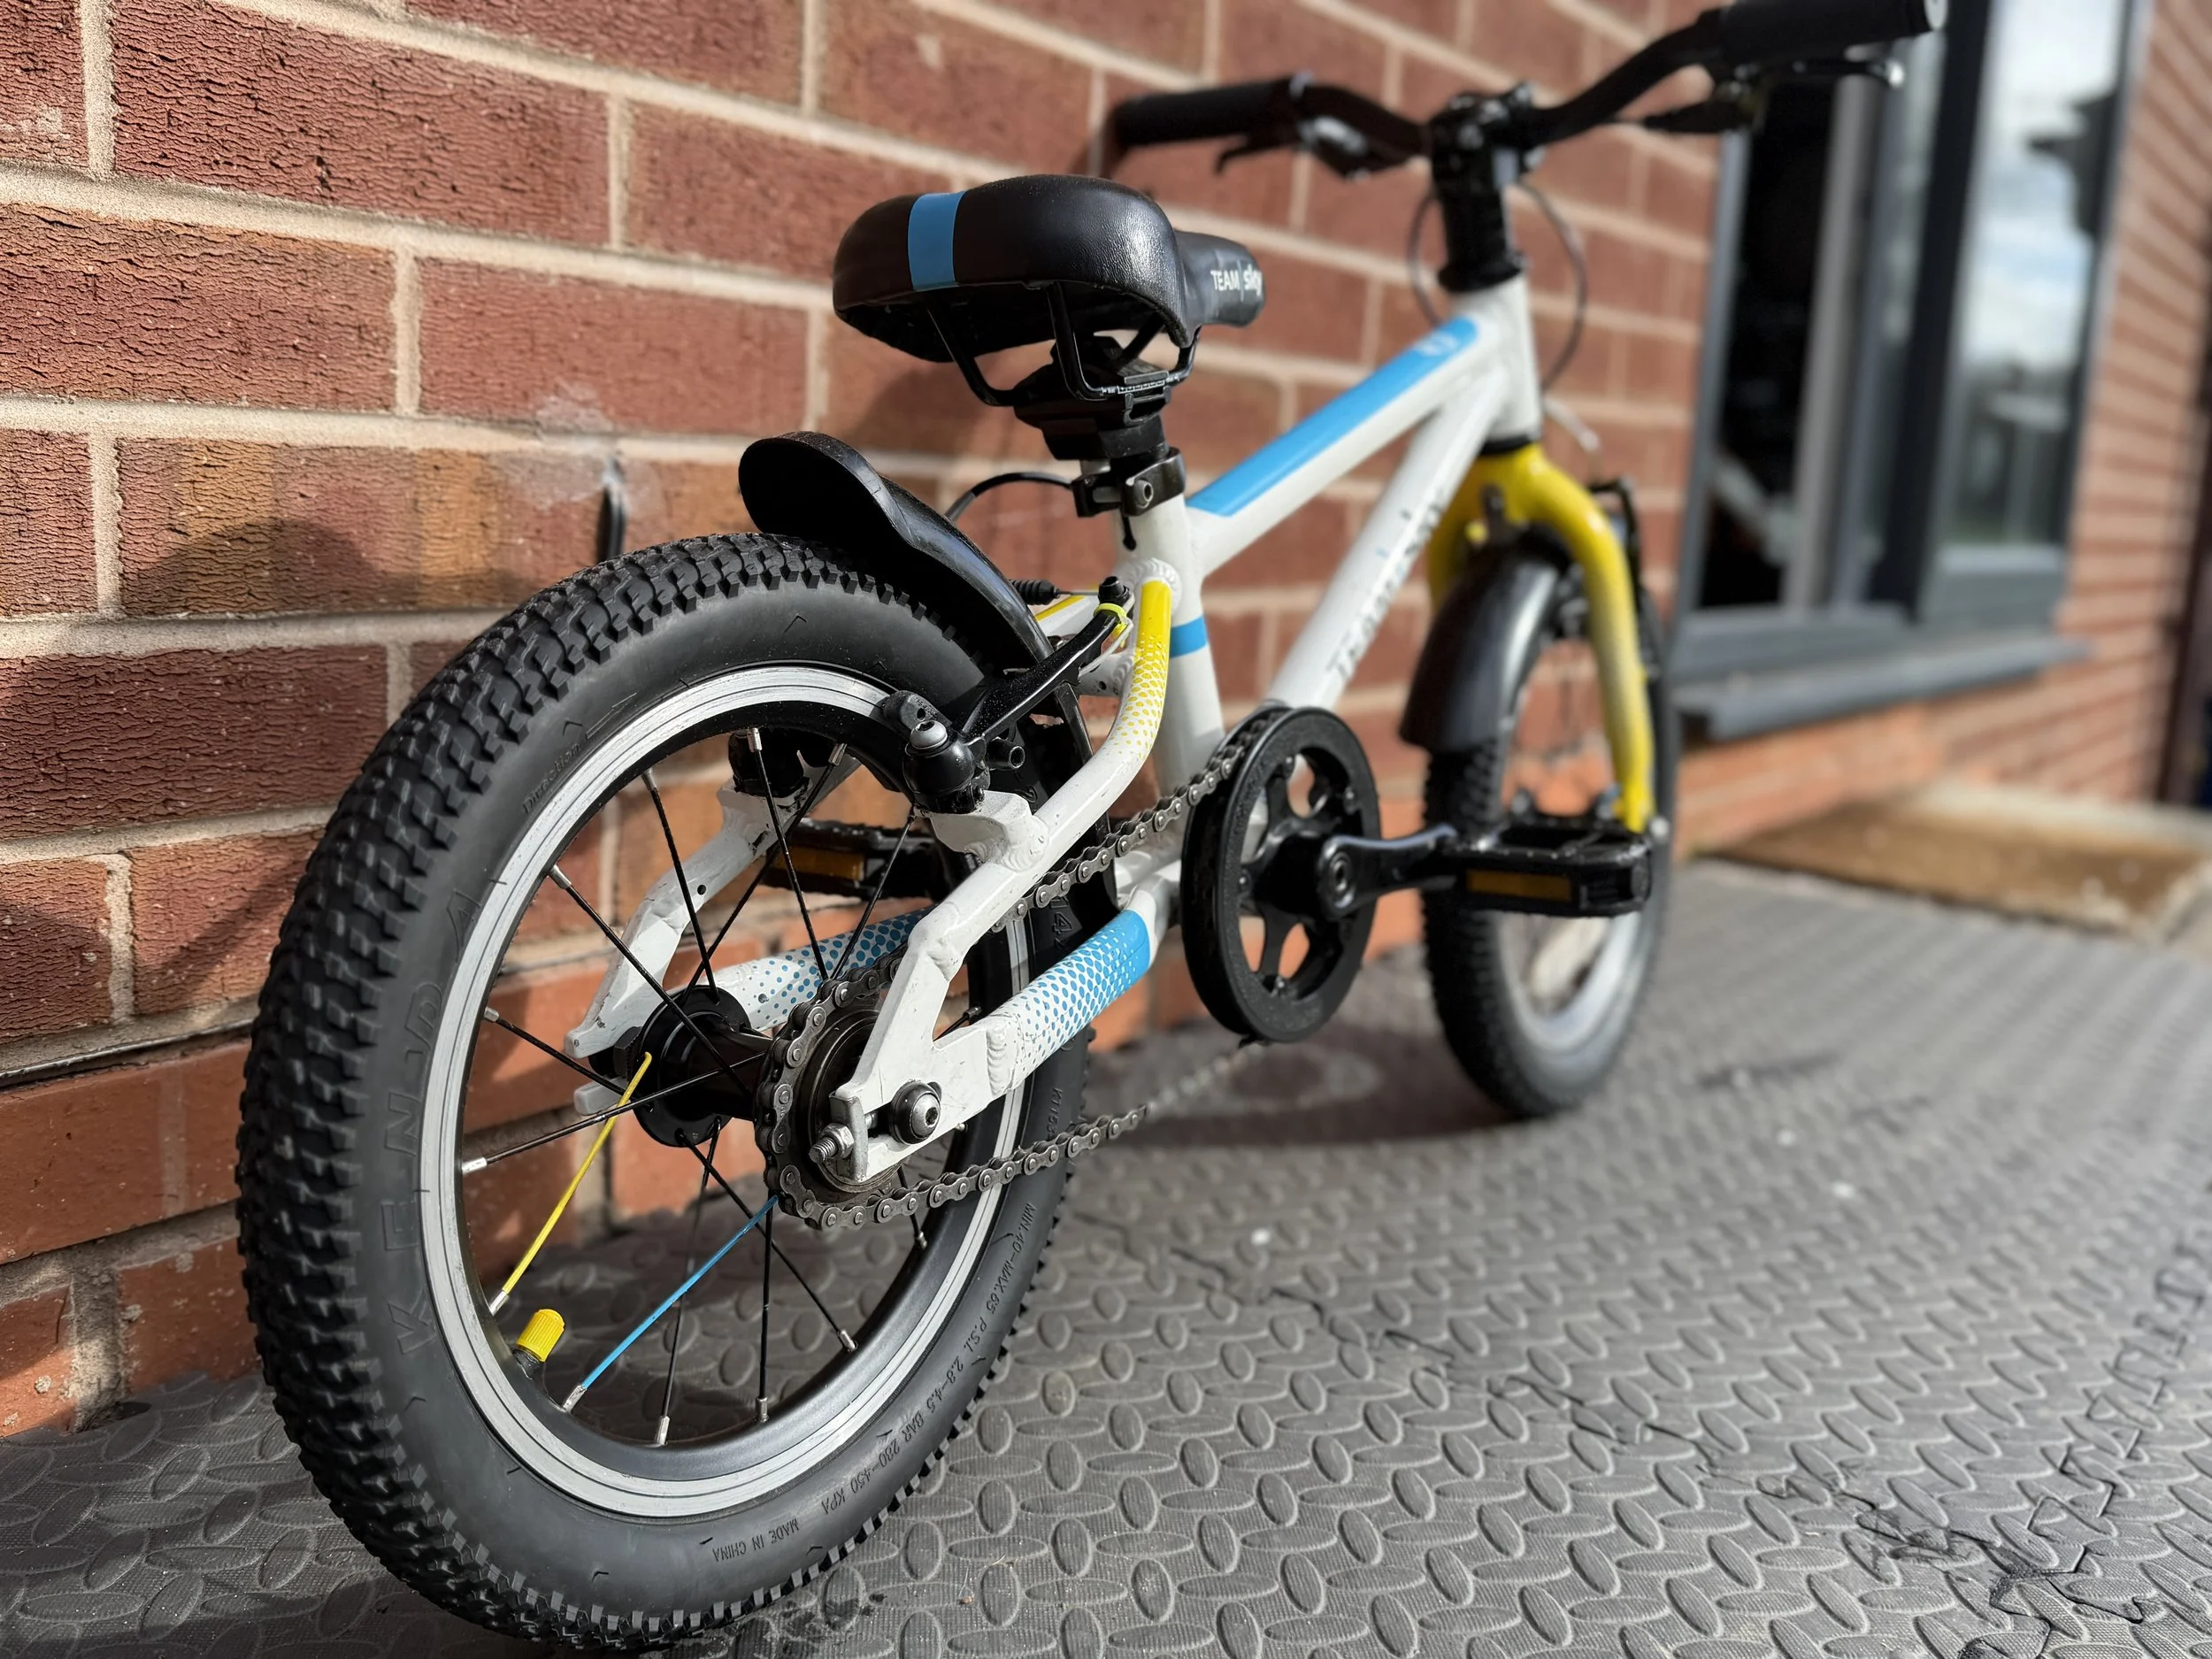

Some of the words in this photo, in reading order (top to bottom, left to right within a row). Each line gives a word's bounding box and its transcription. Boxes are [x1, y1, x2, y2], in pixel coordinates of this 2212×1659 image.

[1210, 269, 1240, 291] TEAM
[380, 887, 482, 1355] KENDA
[963, 1316, 987, 1353] P.S.I.
[901, 1409, 925, 1443] BAR
[820, 1487, 847, 1515] KPA
[751, 1533, 765, 1552] IN
[768, 1517, 801, 1545] MADE
[711, 1540, 748, 1563] CHINA
